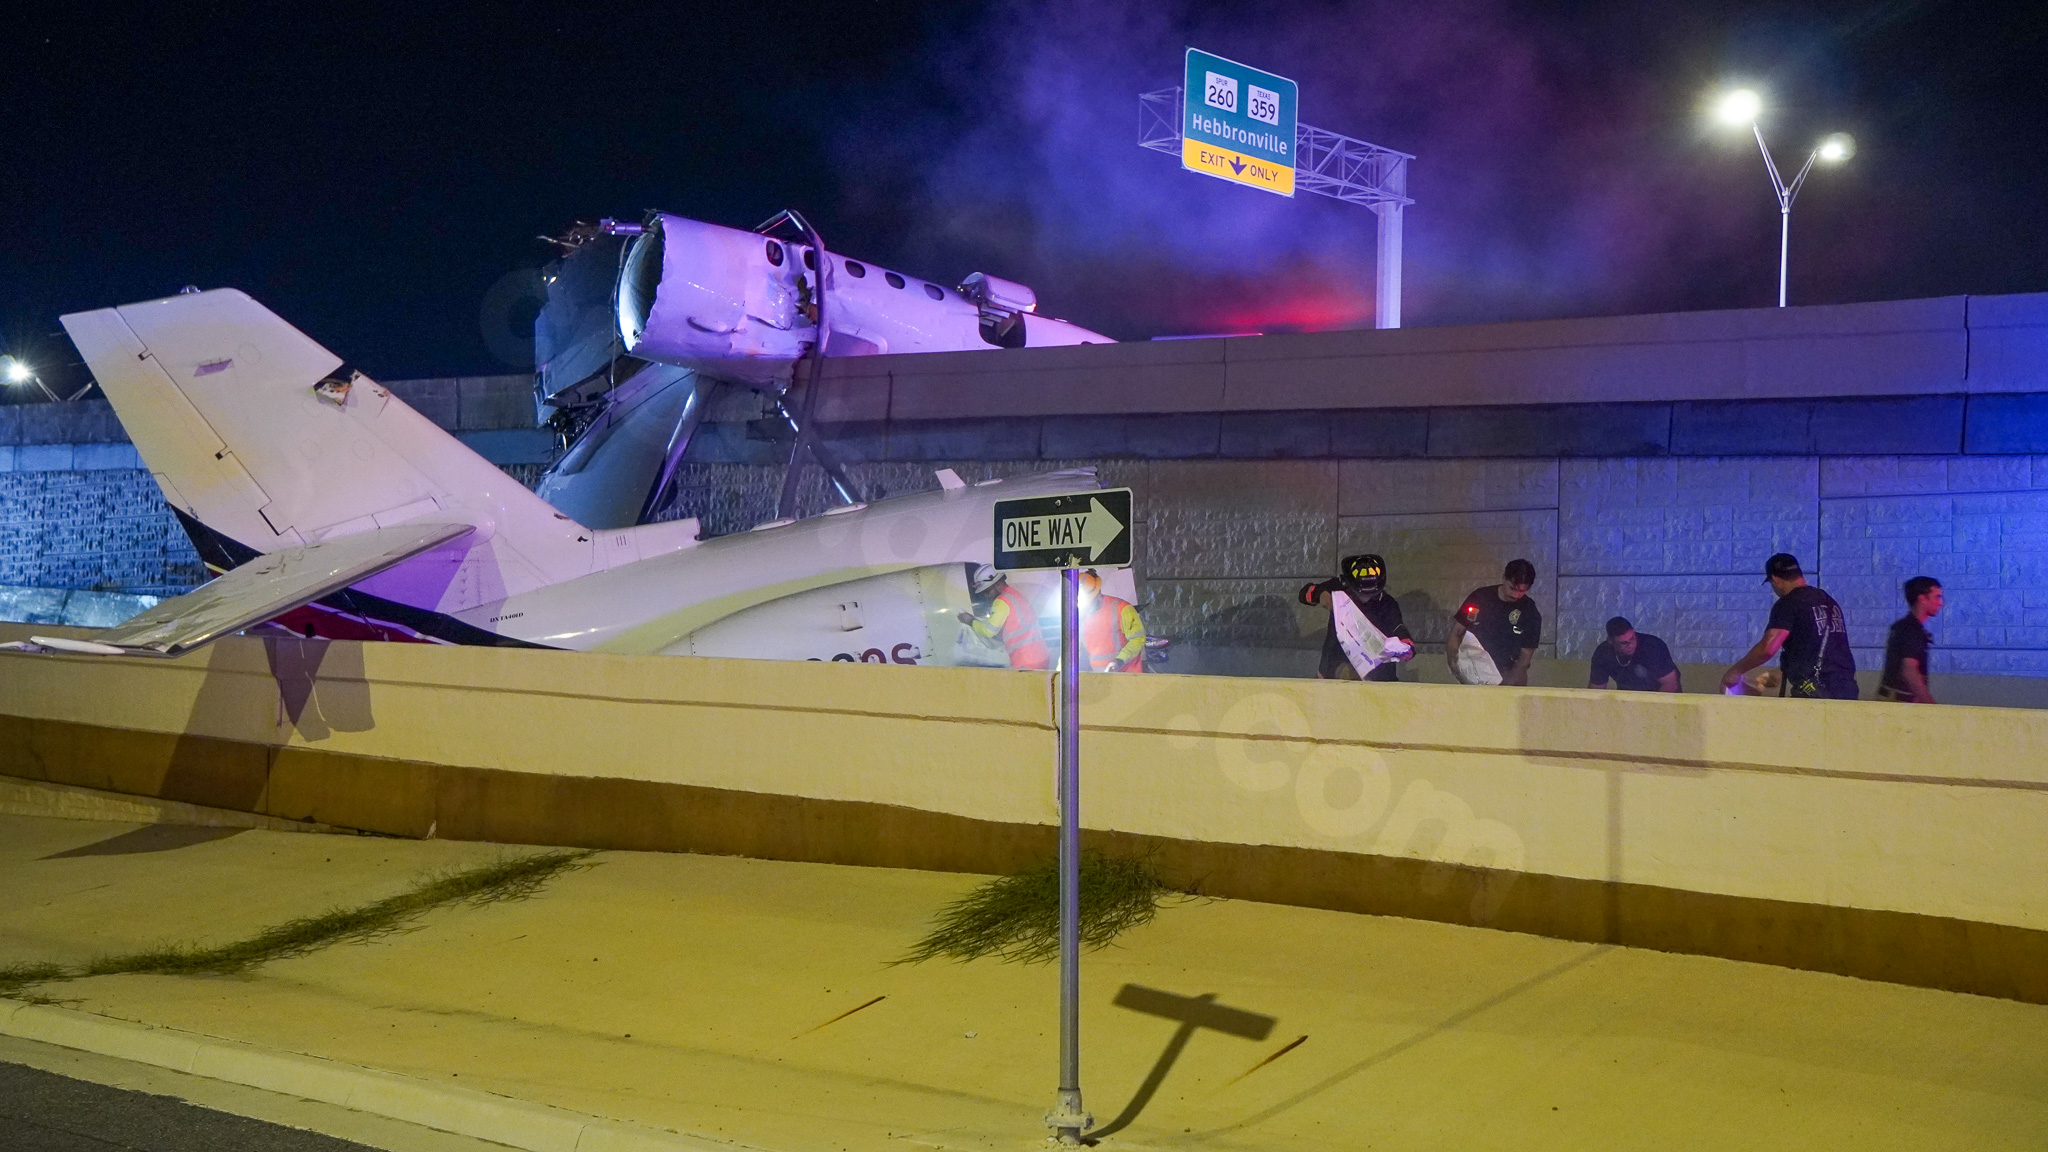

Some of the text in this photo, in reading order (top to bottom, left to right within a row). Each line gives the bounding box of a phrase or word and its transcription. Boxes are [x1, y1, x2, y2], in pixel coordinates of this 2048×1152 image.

[1215, 77, 1228, 86] SPUR
[1208, 85, 1234, 108] 260
[1257, 90, 1271, 100] TEXAS
[1251, 98, 1276, 120] 359
[1192, 113, 1288, 155] Hebbronville
[1200, 150, 1279, 182] EXIT ONLY
[1006, 516, 1088, 548] ONE WAY
